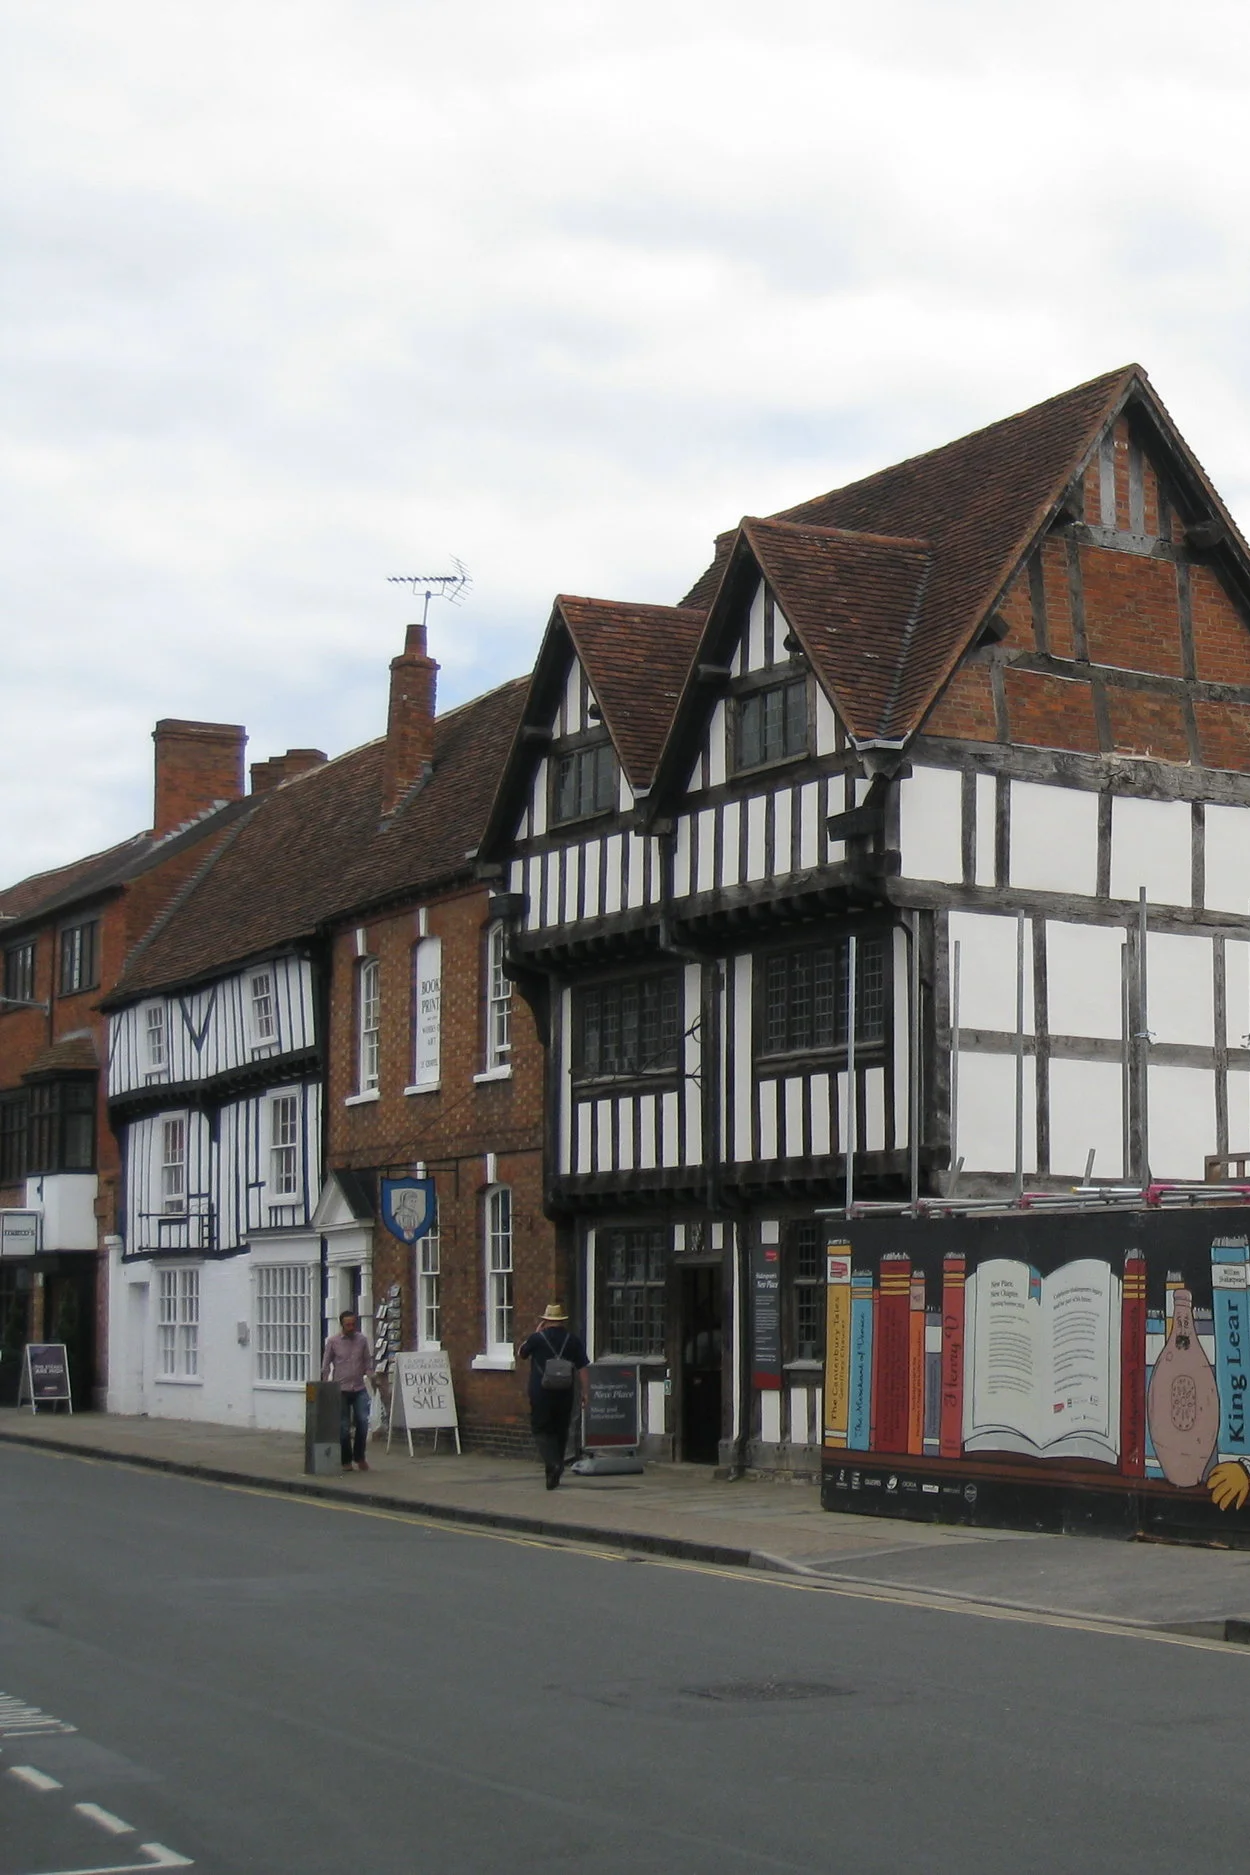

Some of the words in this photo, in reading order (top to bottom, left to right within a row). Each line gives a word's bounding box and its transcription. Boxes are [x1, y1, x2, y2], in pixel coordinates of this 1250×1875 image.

[833, 1296, 841, 1326] Tales
[1226, 1299, 1242, 1366] Lear
[405, 1372, 450, 1386] BOOKS
[831, 1329, 841, 1397] Canterbury
[944, 1343, 961, 1408] Henry
[412, 1395, 448, 1410] SALE
[417, 1386, 437, 1395] FOR
[1229, 1374, 1248, 1444] King
